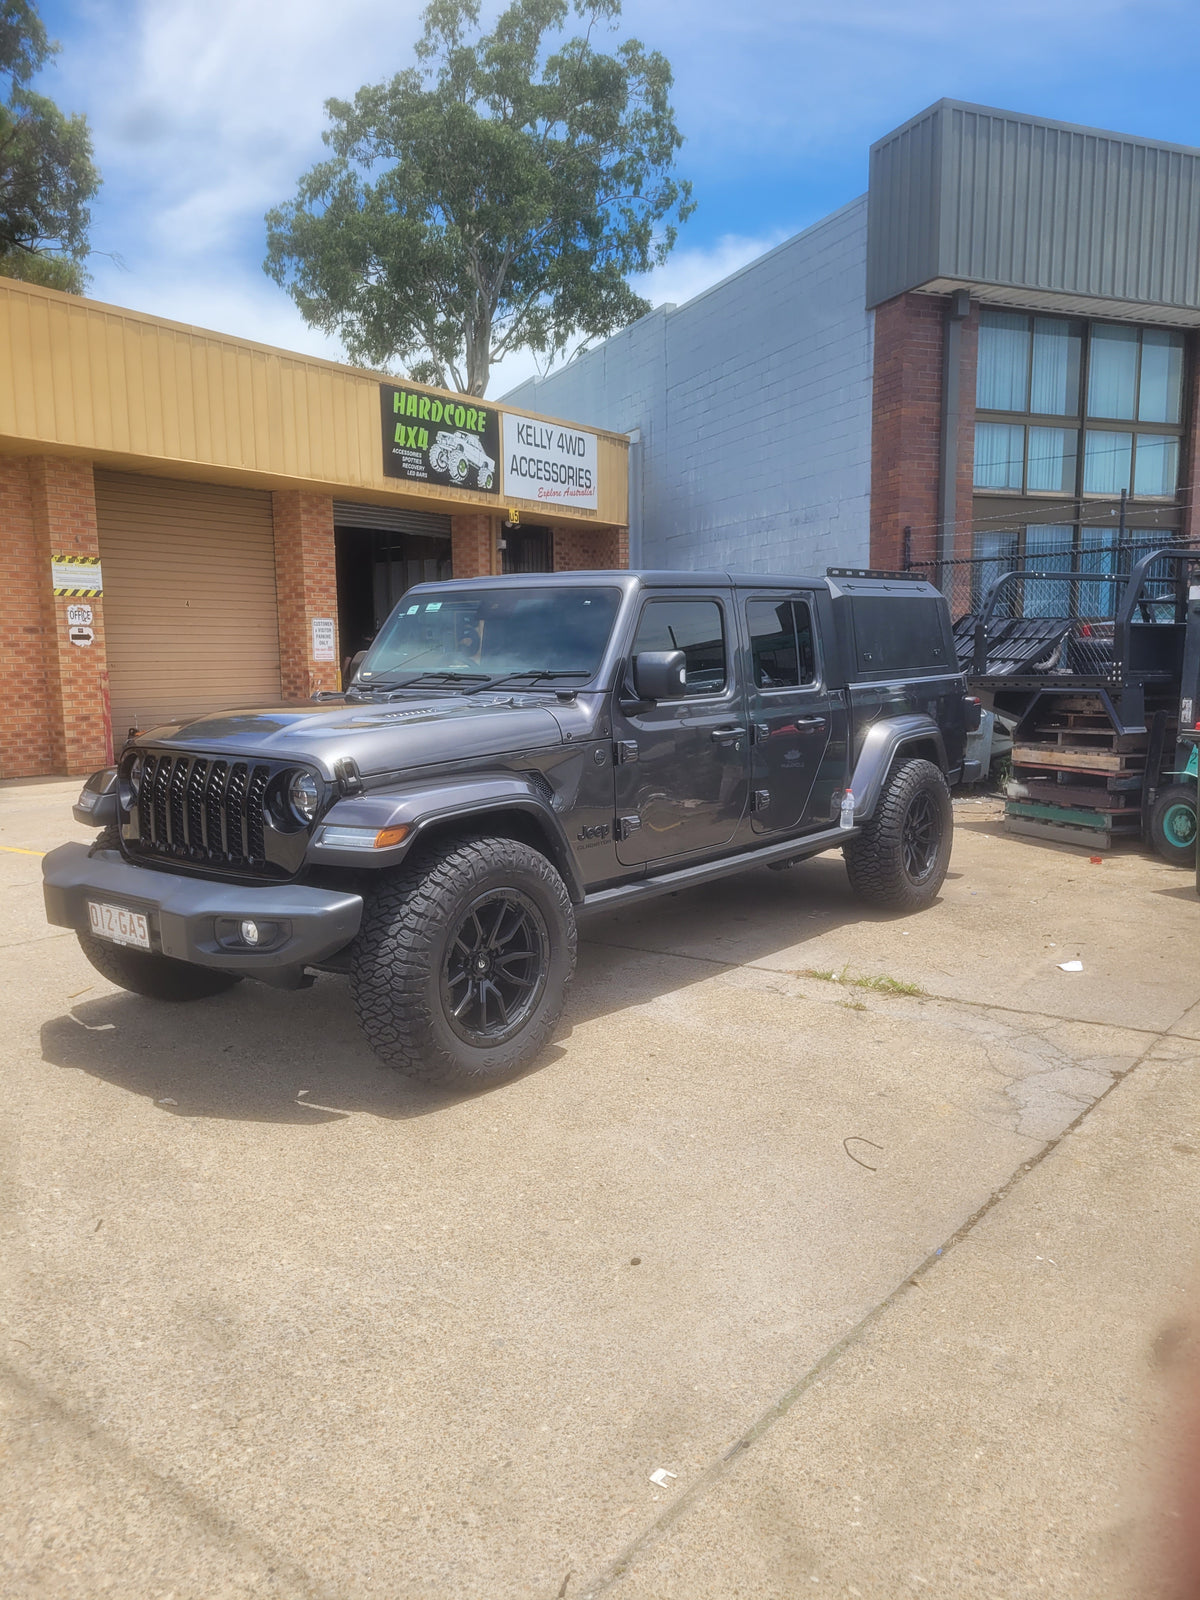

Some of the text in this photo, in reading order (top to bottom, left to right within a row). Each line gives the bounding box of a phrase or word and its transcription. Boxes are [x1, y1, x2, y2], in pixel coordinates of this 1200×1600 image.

[393, 391, 487, 433] HARDCORE
[394, 422, 429, 451] 4X4
[517, 422, 586, 457] KELLY 4WD
[392, 448, 423, 458] ACCESSORIES
[402, 463, 426, 471] RECOVERY
[510, 454, 592, 489] ACCESSORIES
[537, 485, 596, 499] Explore Australia!
[69, 610, 91, 620] OFFICE
[577, 823, 609, 841] Jeep
